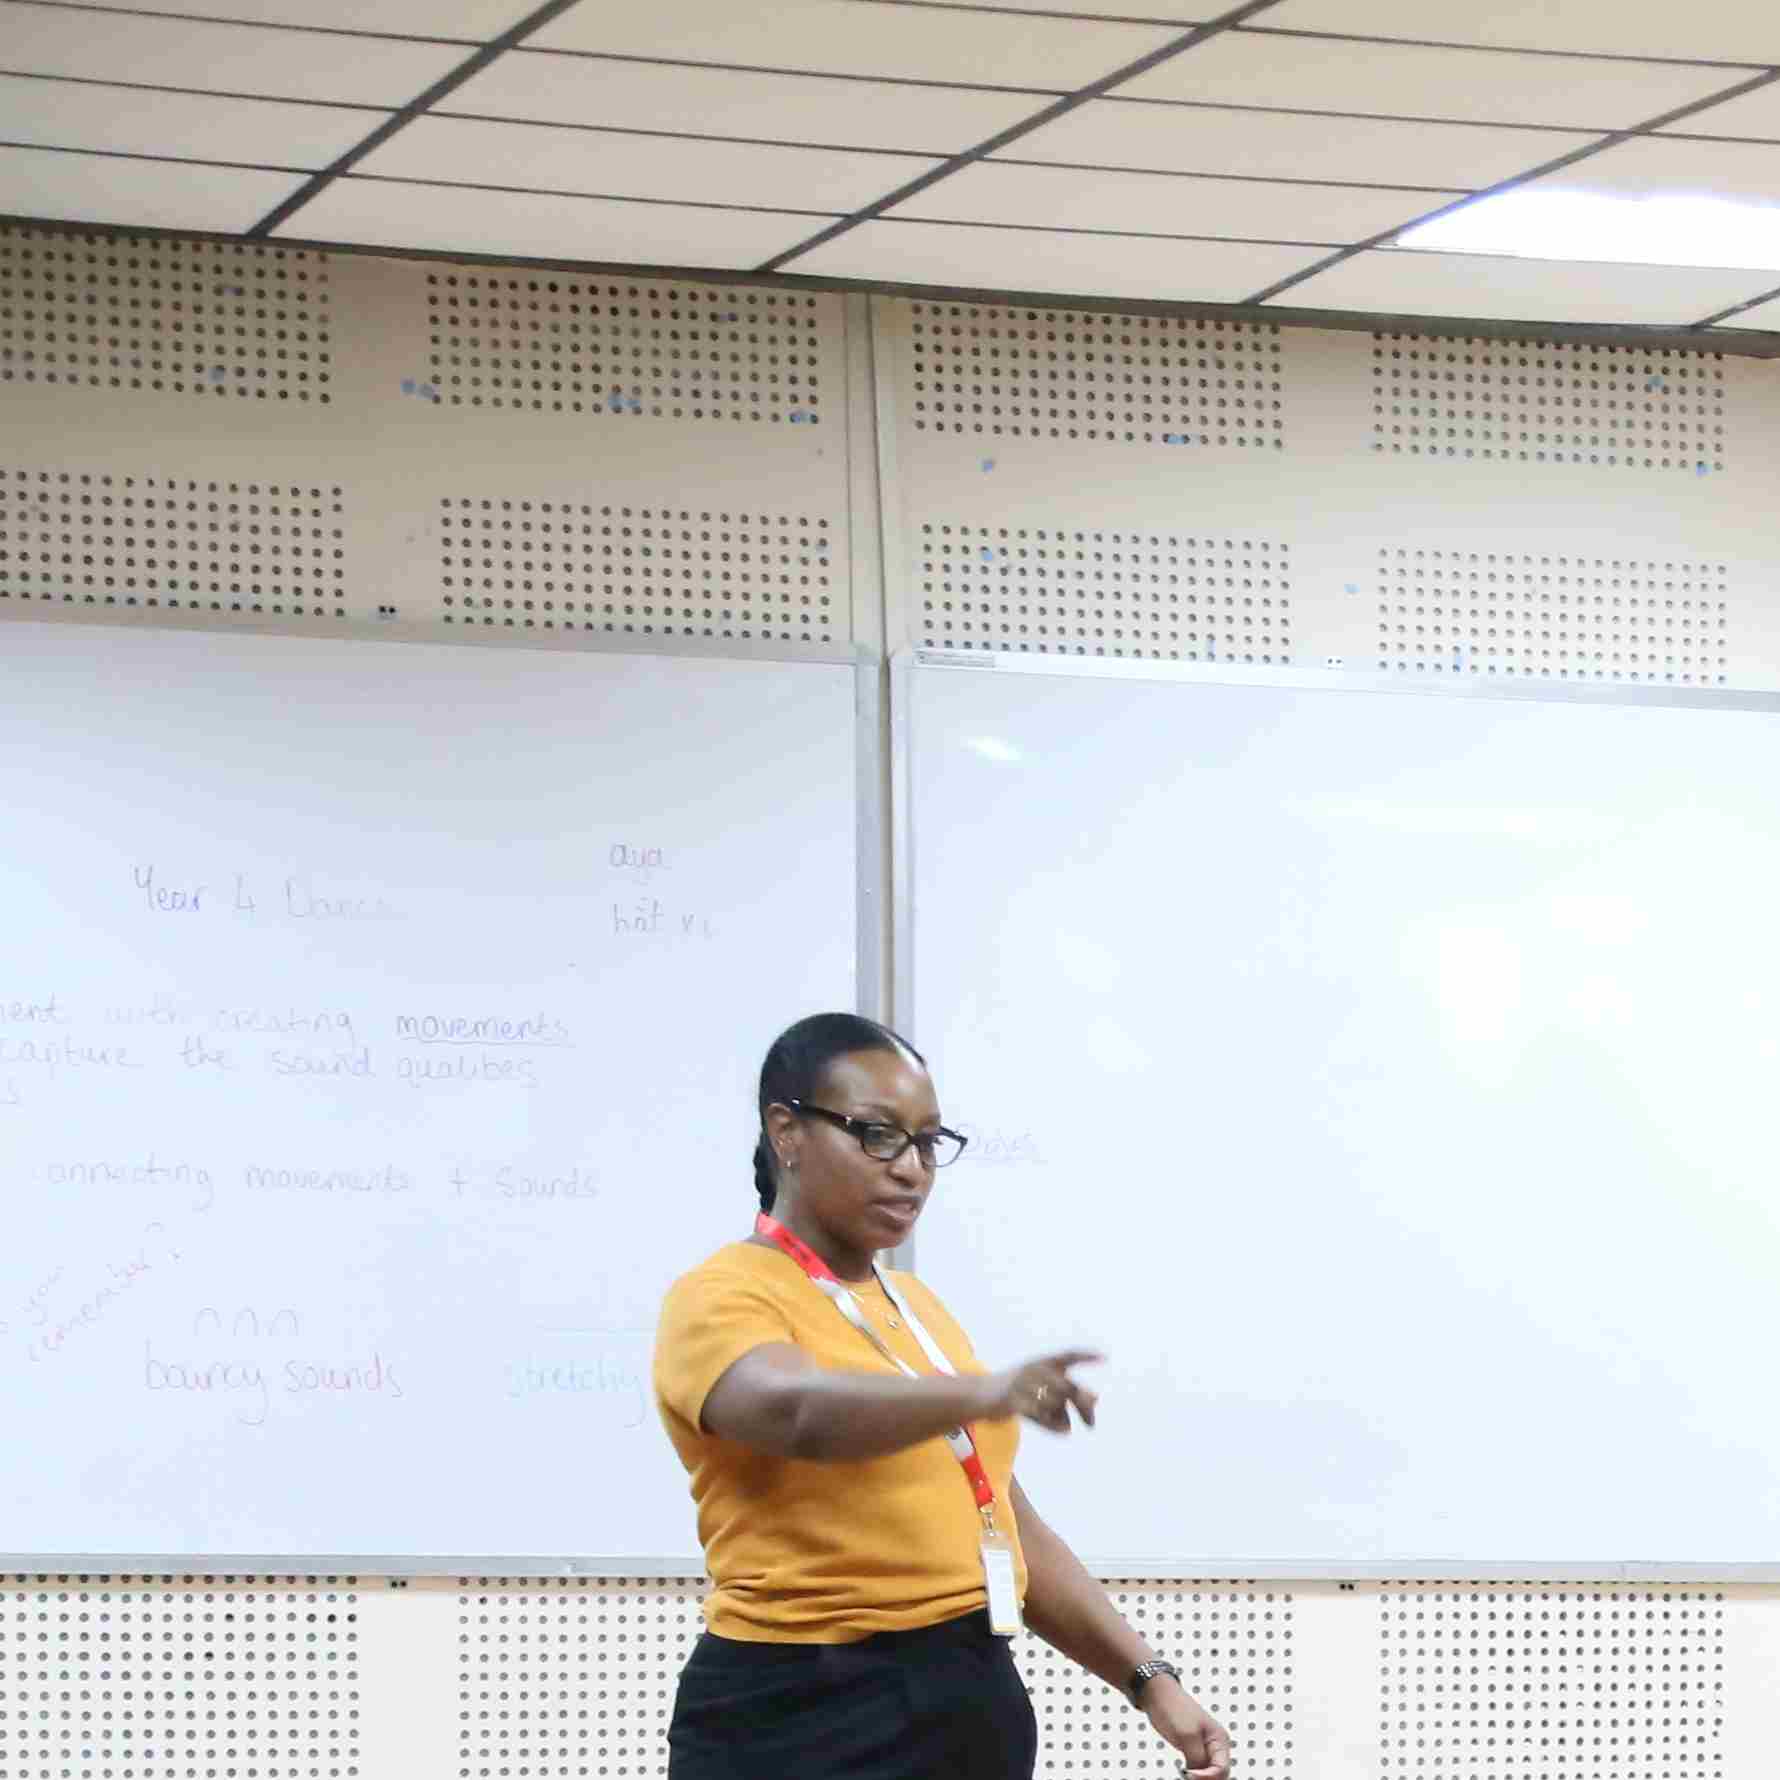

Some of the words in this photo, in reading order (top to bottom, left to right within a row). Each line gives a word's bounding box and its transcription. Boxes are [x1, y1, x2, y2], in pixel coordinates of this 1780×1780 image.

[131, 864, 206, 913] Year
[232, 870, 257, 914] 4
[216, 1008, 358, 1050] creating
[396, 1009, 570, 1041] movements
[177, 1030, 234, 1072] the
[271, 1047, 377, 1080] sound
[244, 1159, 411, 1192] movements
[281, 1351, 405, 1399] sounds
[503, 1352, 645, 1431] stretchy
